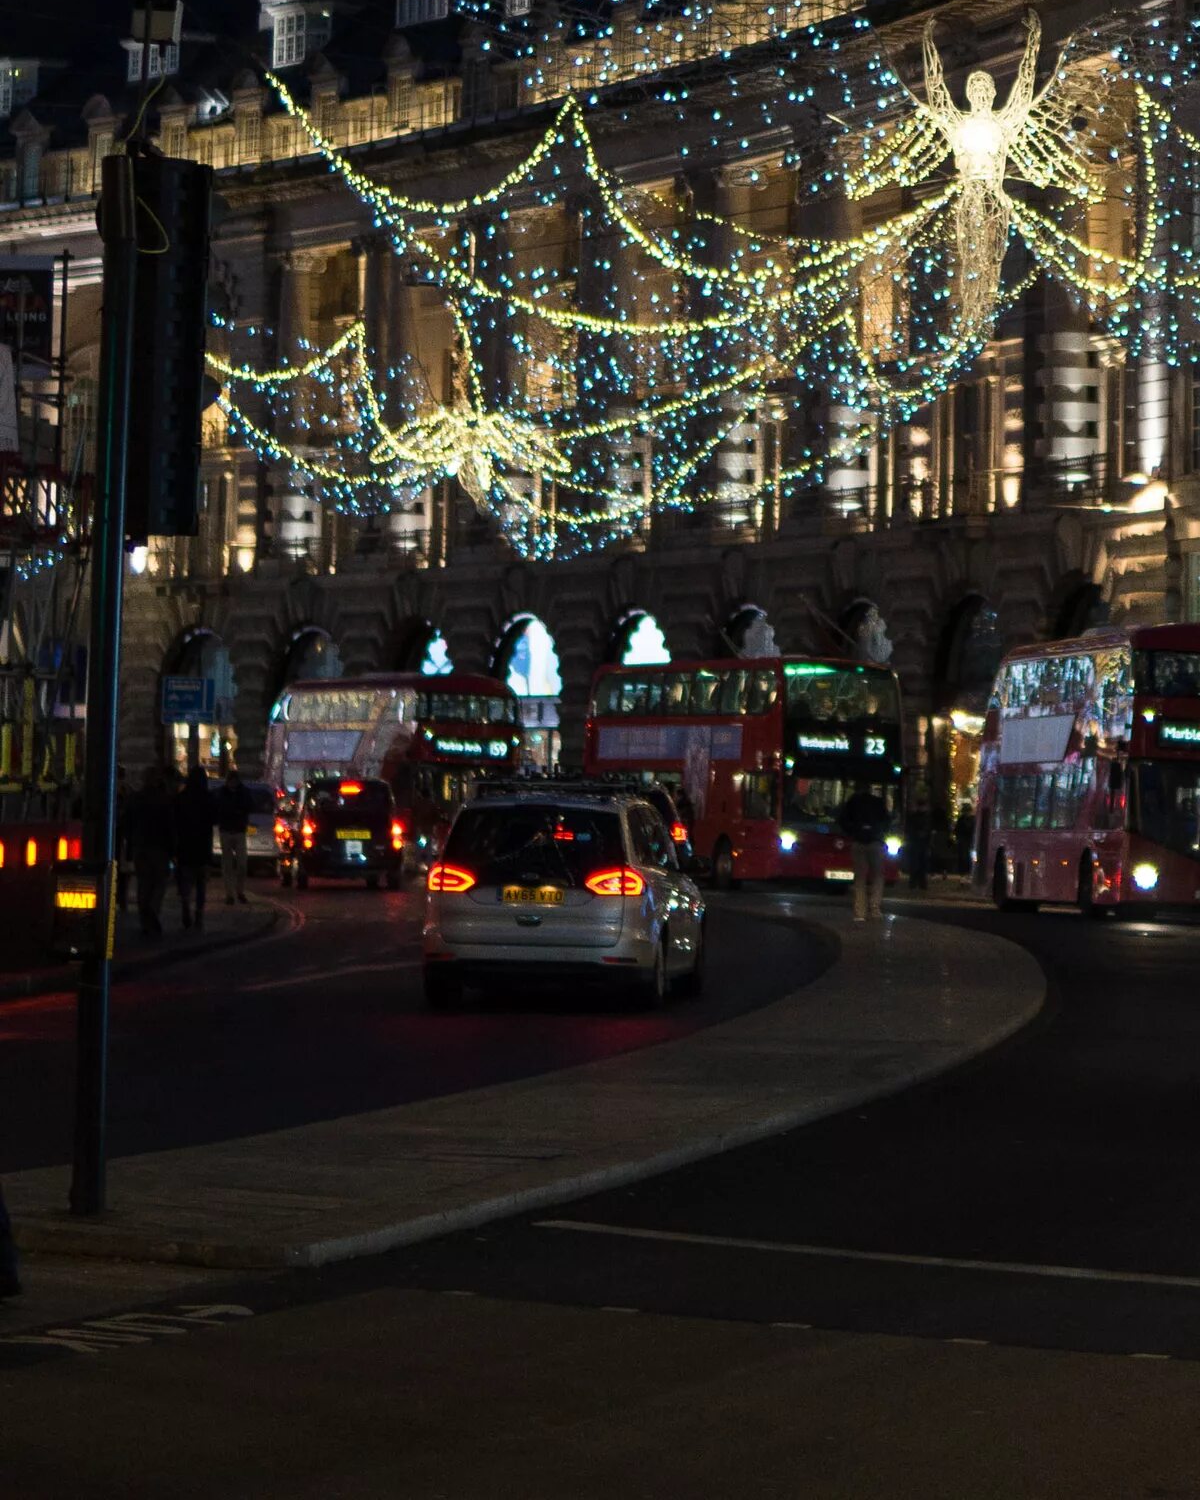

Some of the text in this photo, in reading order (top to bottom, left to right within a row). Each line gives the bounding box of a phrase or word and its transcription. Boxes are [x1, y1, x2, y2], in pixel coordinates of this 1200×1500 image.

[489, 741, 508, 756] 159
[865, 738, 885, 754] 23
[57, 892, 96, 909] WAIT
